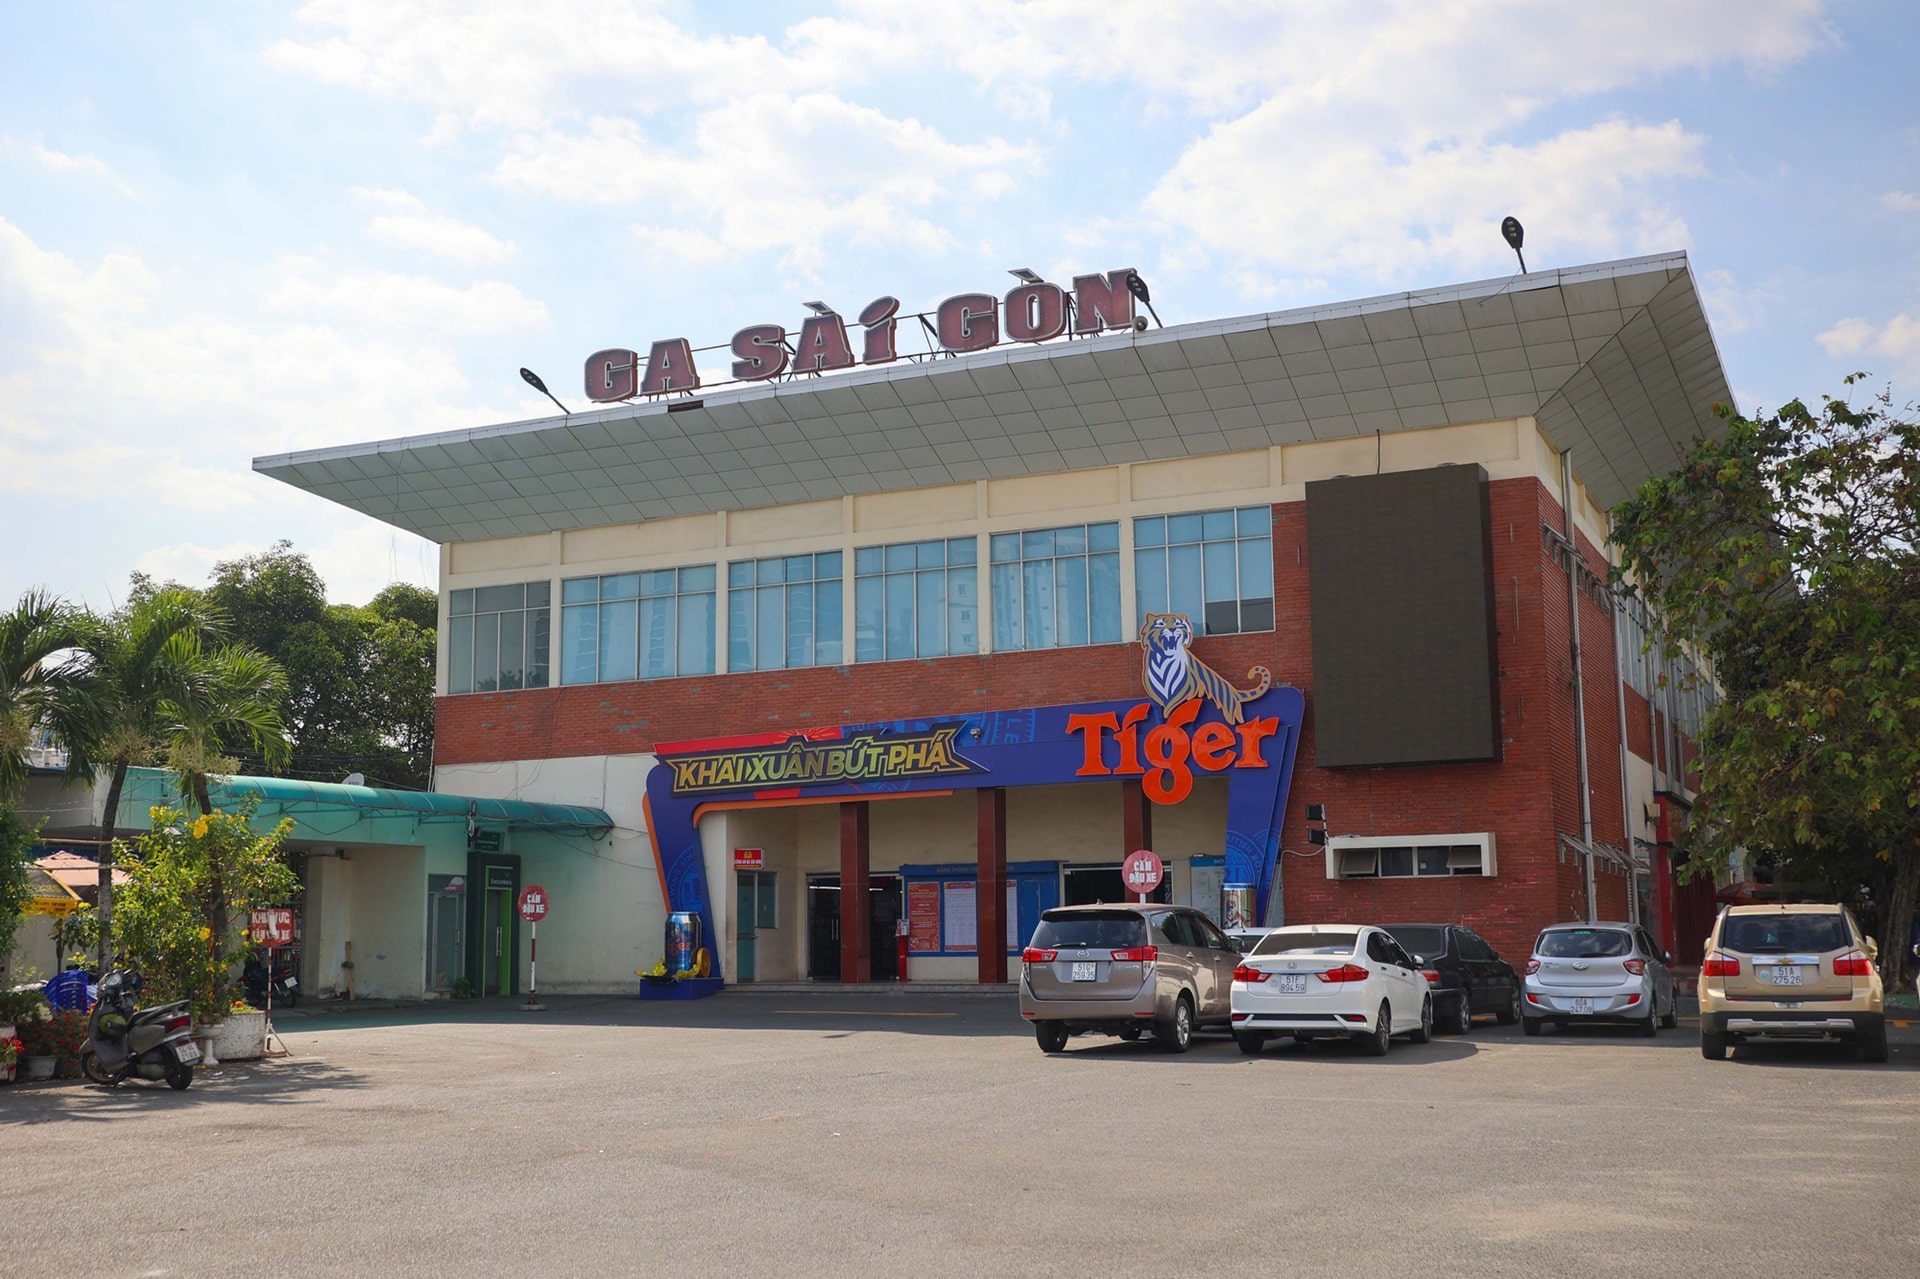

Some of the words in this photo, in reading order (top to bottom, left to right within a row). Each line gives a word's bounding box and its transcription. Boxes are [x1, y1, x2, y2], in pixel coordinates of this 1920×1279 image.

[584, 337, 700, 402] GA
[937, 267, 1138, 352] GÒN
[1065, 698, 1280, 805] Tiger
[678, 756, 744, 787] KHAI
[747, 743, 822, 781] XUÂN
[887, 733, 950, 771] PHÁ
[1133, 857, 1152, 871] CẤM
[1145, 872, 1157, 883] XE
[527, 891, 541, 903] CẤM
[535, 904, 545, 913] XE
[1778, 966, 1794, 975] 51A
[1286, 975, 1300, 983] 51F
